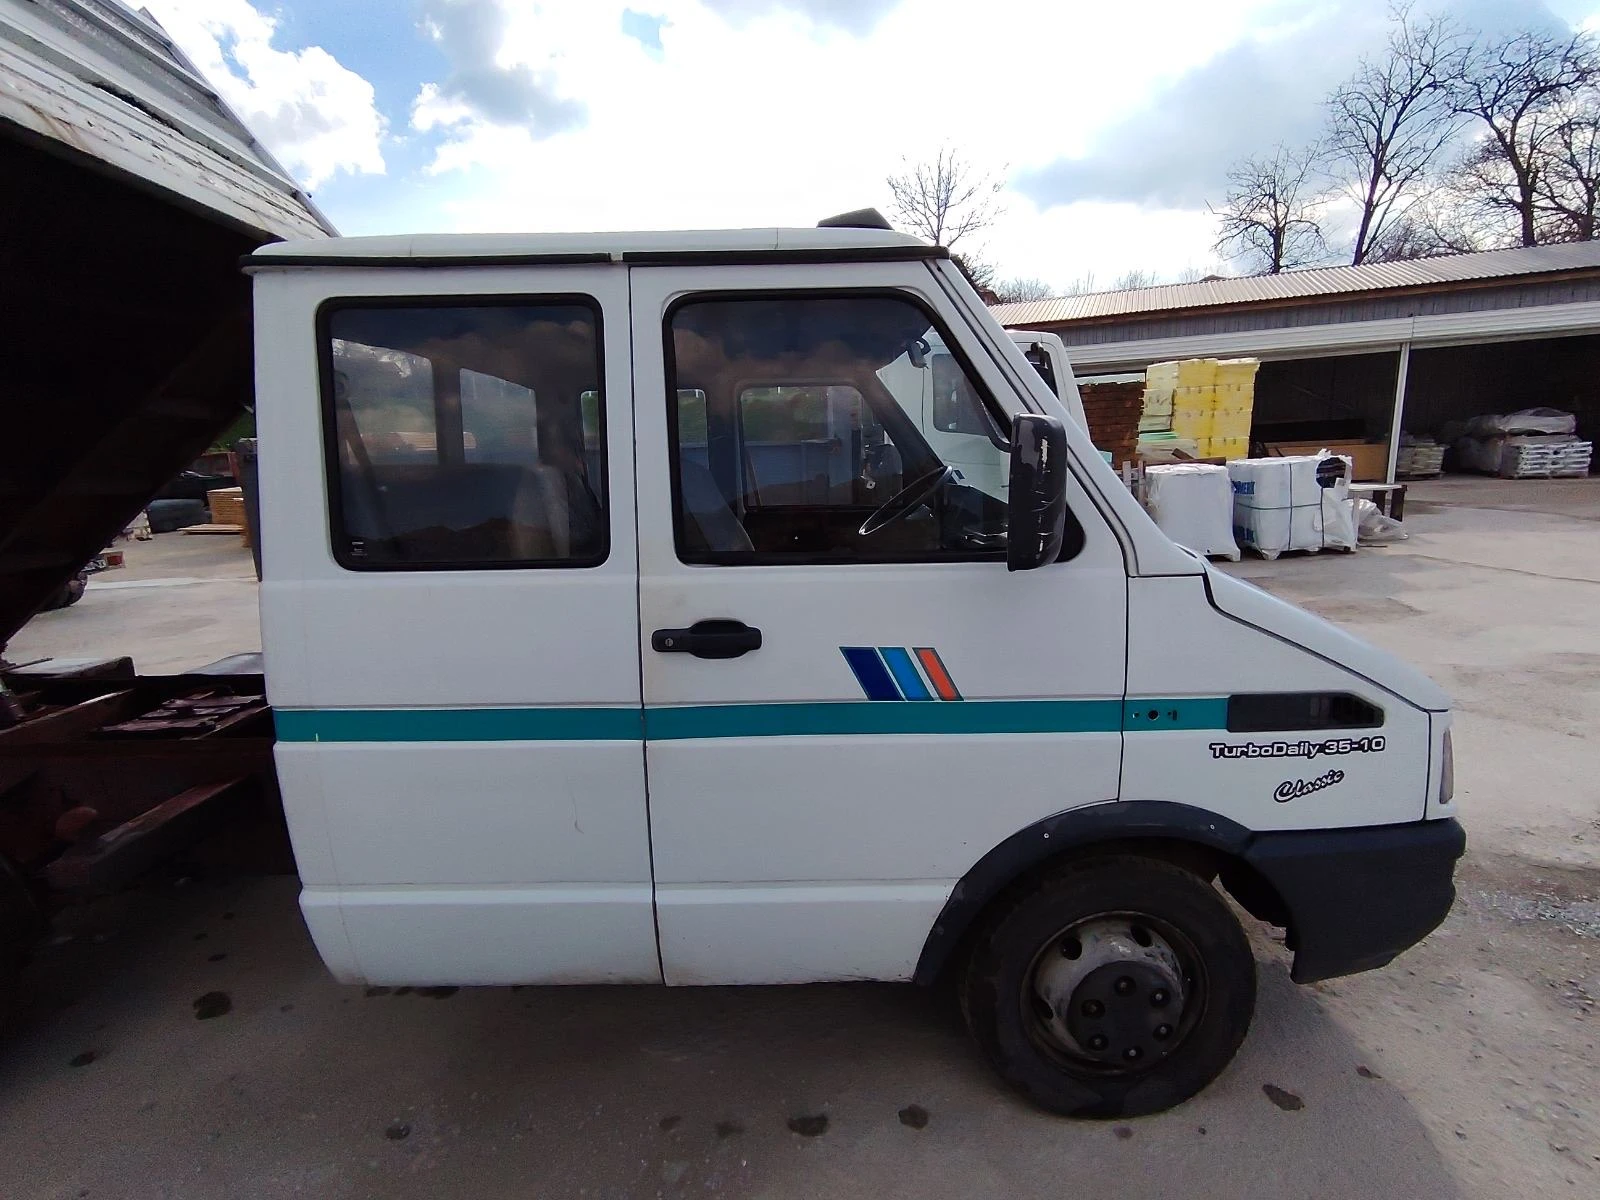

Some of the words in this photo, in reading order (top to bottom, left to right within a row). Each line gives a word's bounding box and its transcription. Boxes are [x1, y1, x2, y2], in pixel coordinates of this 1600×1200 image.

[1210, 742, 1319, 758] TurboDaily
[1324, 737, 1385, 754] 35-10
[1274, 769, 1344, 802] Classic
